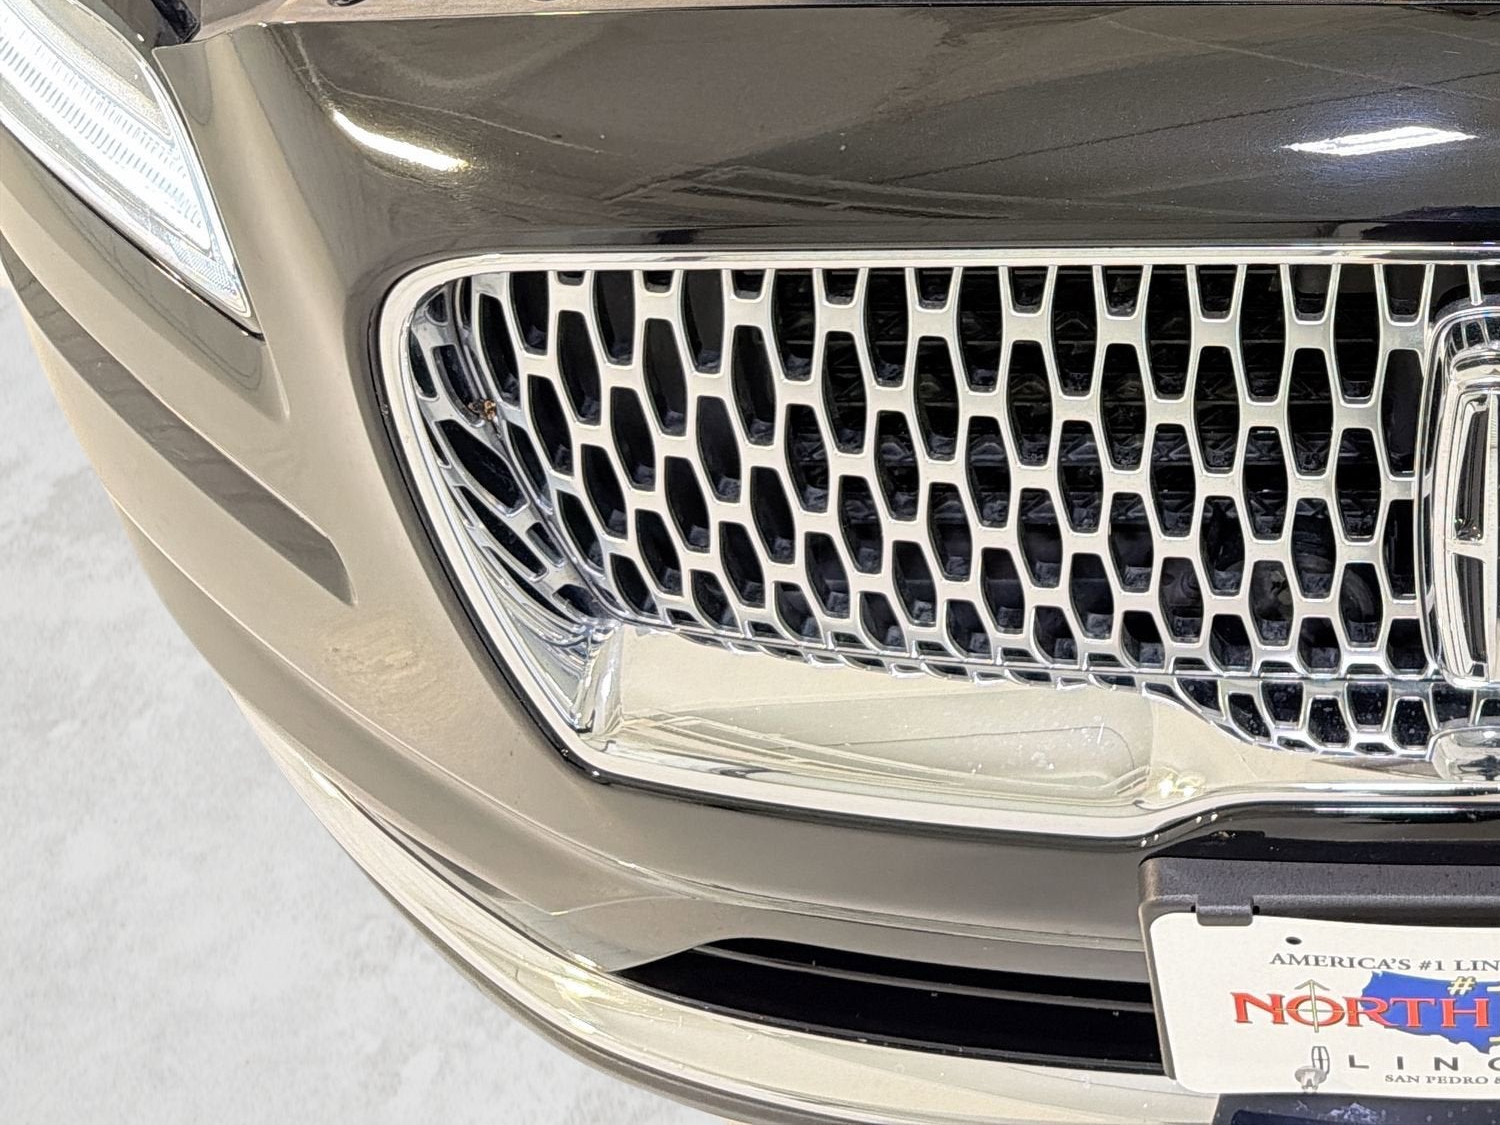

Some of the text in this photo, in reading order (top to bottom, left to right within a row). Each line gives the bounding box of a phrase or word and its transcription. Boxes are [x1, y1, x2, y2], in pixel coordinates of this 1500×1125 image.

[1418, 960, 1446, 971] #1
[1230, 992, 1490, 1028] NORTH
[1385, 1074, 1420, 1084] SAN
[1426, 1075, 1489, 1085] PEDRO
